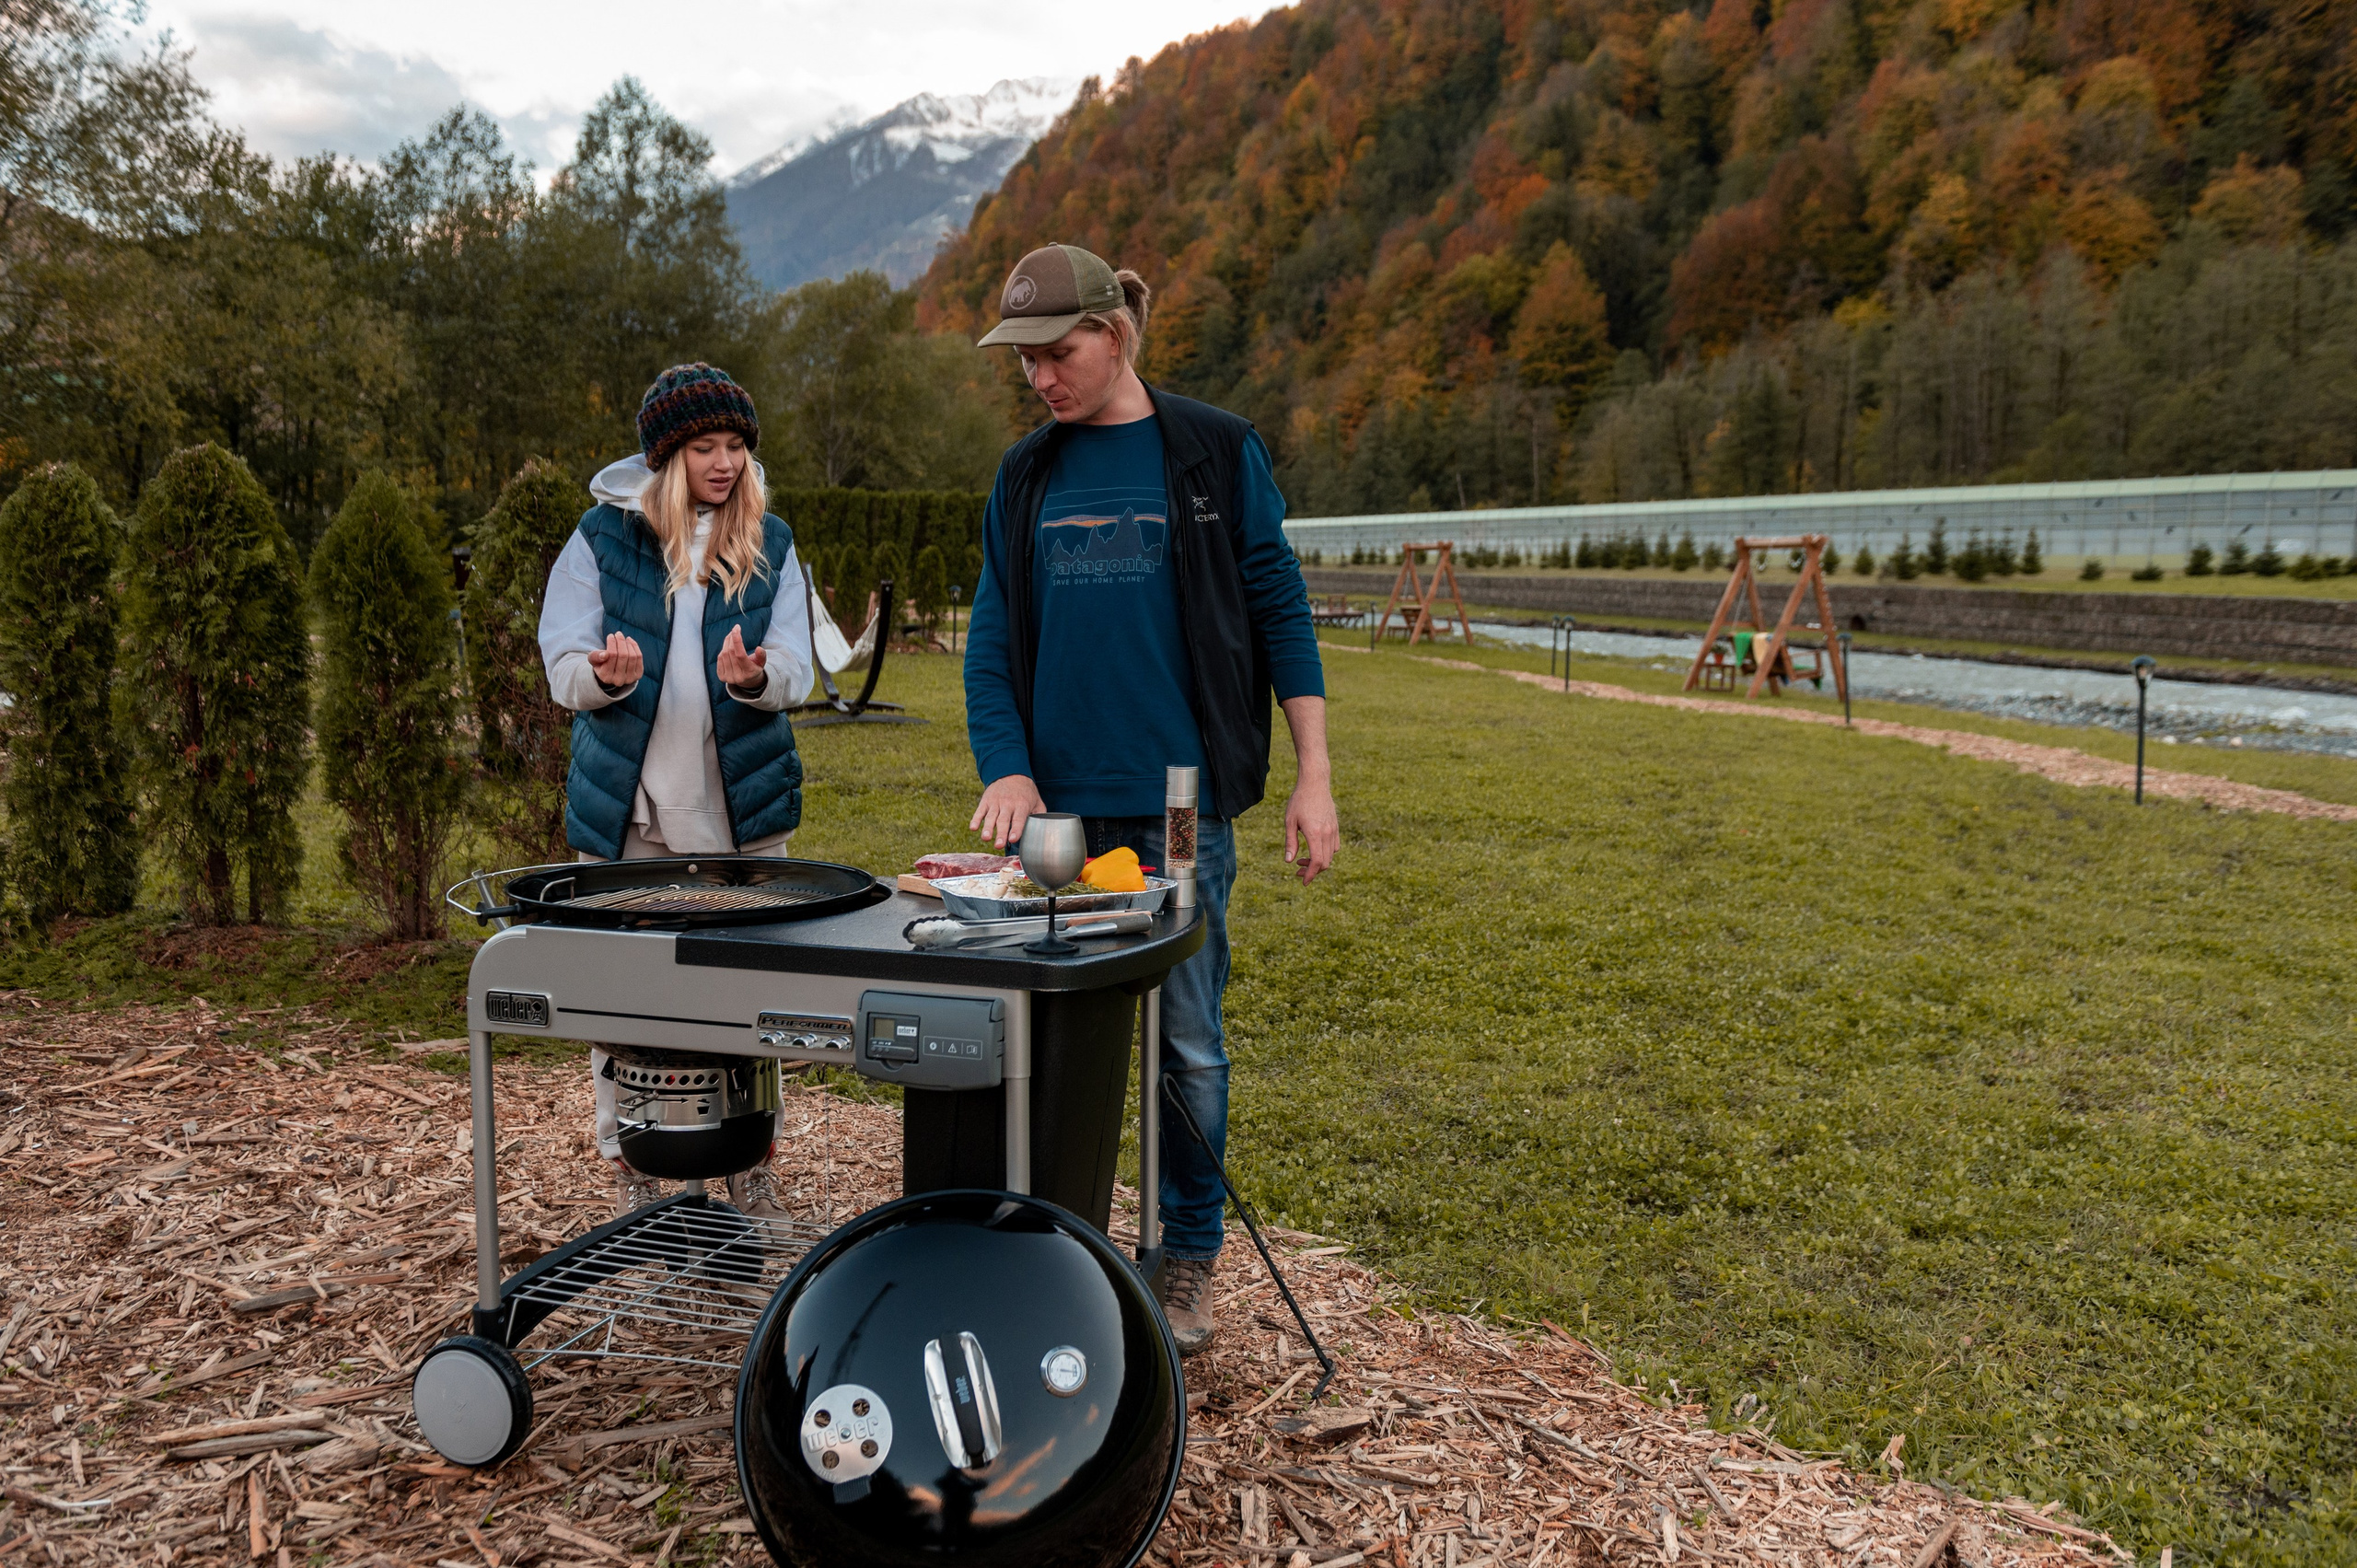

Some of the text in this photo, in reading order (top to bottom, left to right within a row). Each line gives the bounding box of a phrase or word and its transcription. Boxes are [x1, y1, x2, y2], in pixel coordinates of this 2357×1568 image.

[1074, 577, 1088, 586] OUR
[489, 994, 532, 1021] weber
[761, 1016, 847, 1030] PERFORMER
[805, 1416, 879, 1454] weber
